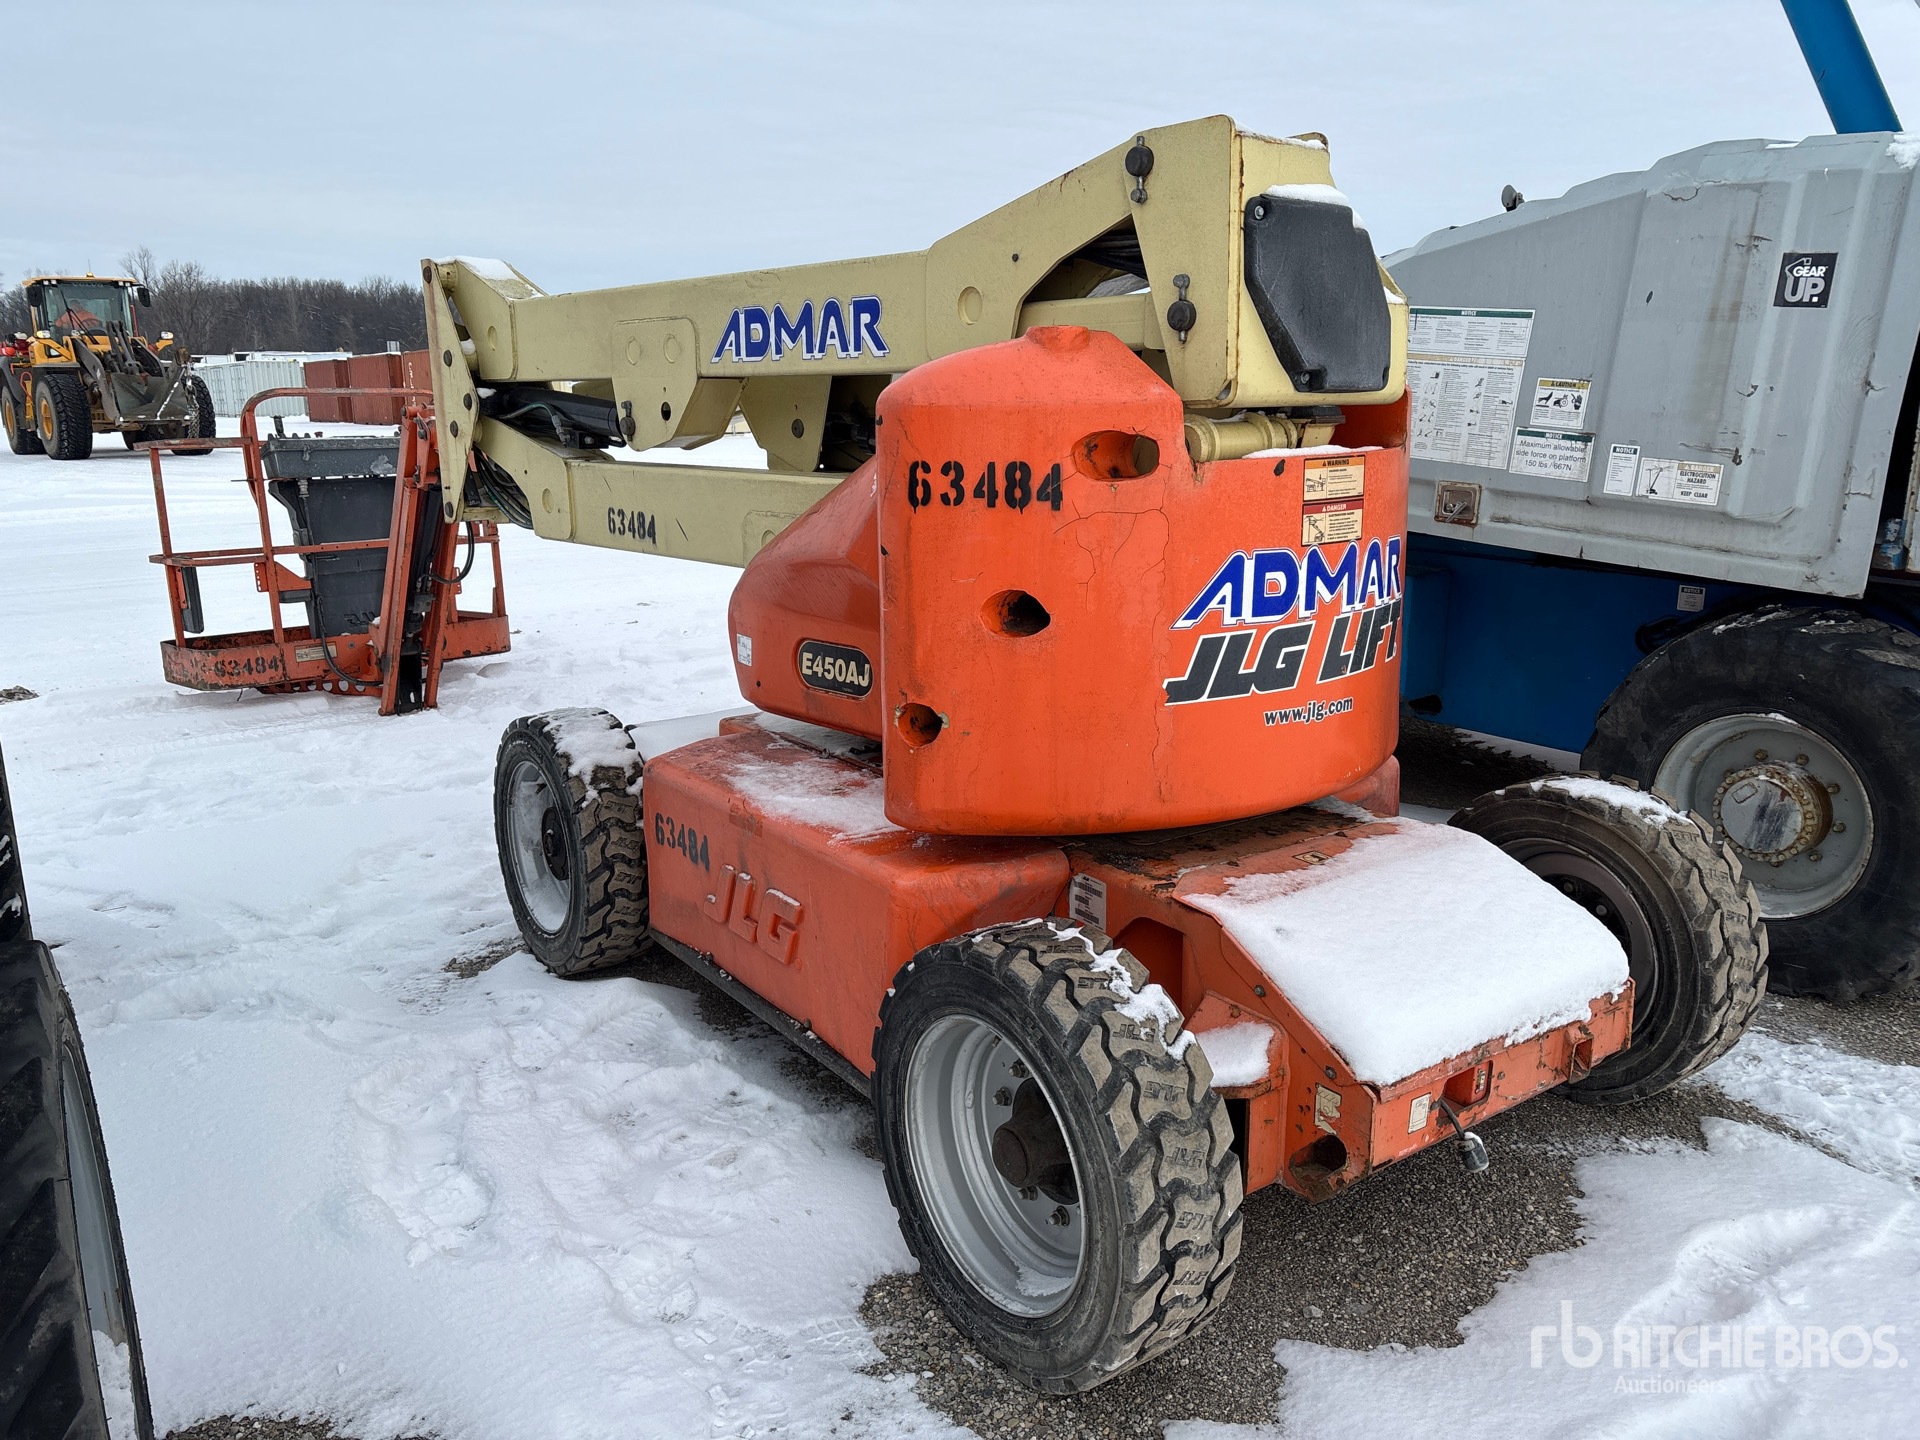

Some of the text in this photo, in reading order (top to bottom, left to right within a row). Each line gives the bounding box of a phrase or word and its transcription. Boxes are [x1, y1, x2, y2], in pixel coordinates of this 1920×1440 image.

[1793, 266, 1827, 277] GEAR
[1784, 277, 1826, 303] UP.
[711, 294, 890, 363] ADMAR
[1520, 440, 1585, 453] Maximum allowable
[1530, 451, 1547, 459] force
[1559, 454, 1587, 464] platform
[1327, 459, 1350, 467] WARNING
[1539, 460, 1548, 468] lbs
[1553, 463, 1572, 471] 667N
[1680, 470, 1716, 479] ELECTROCUTION
[908, 460, 1063, 514] 63484
[1327, 503, 1347, 512] DANGER
[608, 507, 657, 545] 63484
[1169, 535, 1402, 630] ADMAR
[213, 655, 279, 678] 63484
[1162, 601, 1401, 706] JLG LIFT
[802, 652, 870, 687] E450AJ
[1263, 697, 1354, 726] www.jlg.com
[655, 812, 710, 872] 63484
[703, 864, 804, 964] JLG
